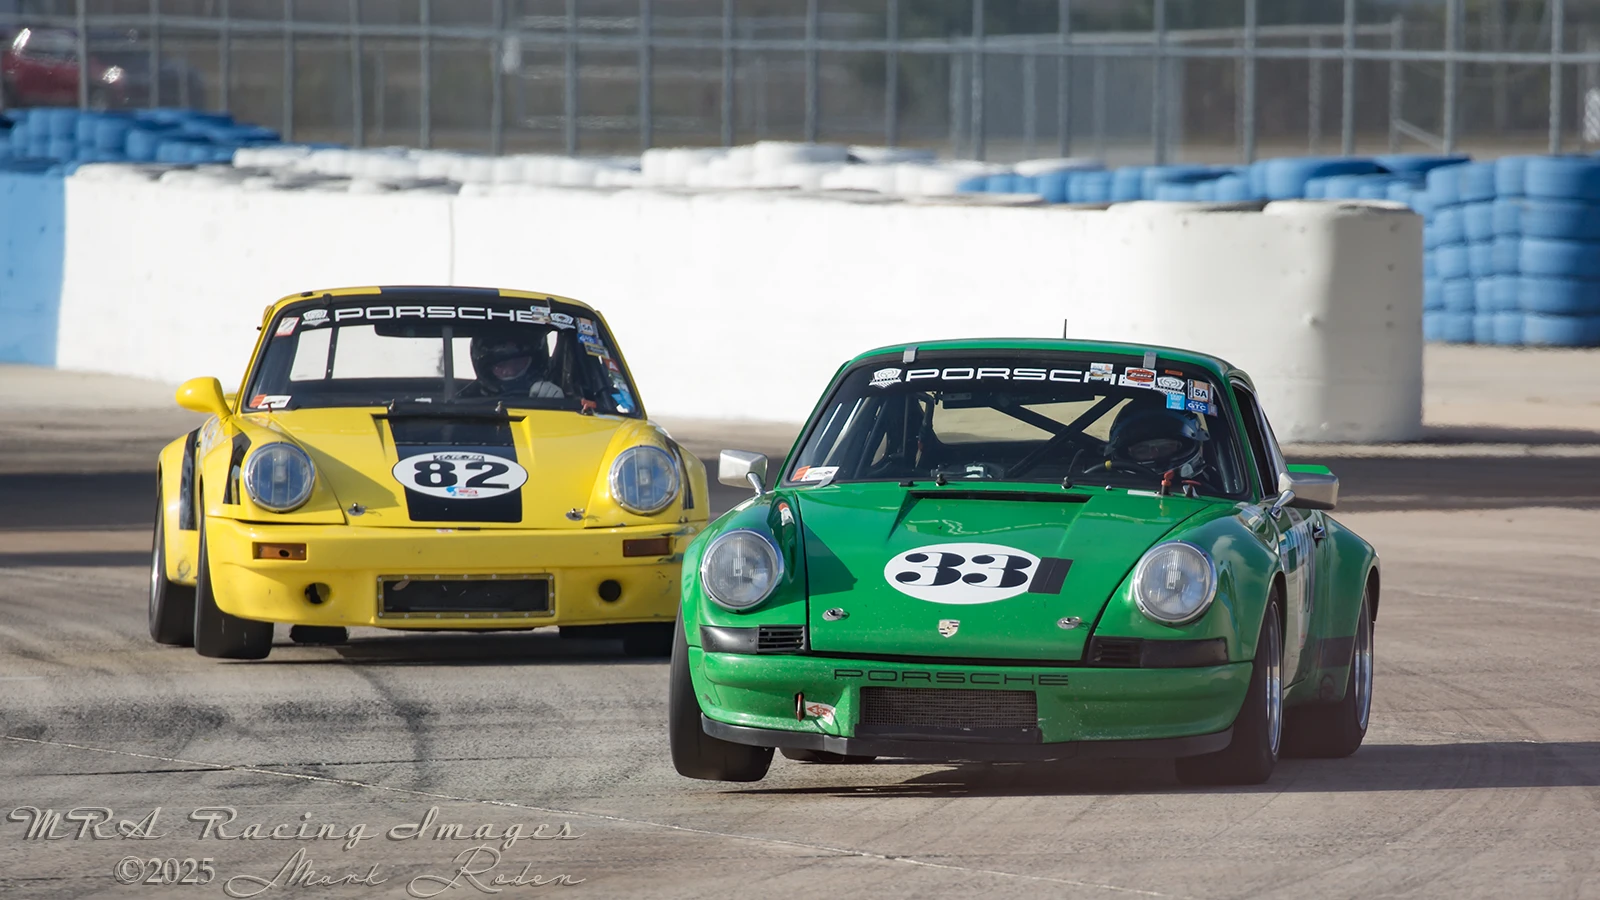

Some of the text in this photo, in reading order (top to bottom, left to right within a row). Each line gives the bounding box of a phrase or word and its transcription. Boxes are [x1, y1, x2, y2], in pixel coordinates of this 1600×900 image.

[1195, 388, 1207, 398] 5A
[1187, 402, 1207, 411] GTC
[413, 460, 510, 489] 82
[894, 551, 1033, 589] 33
[833, 668, 1069, 687] PORSCHE
